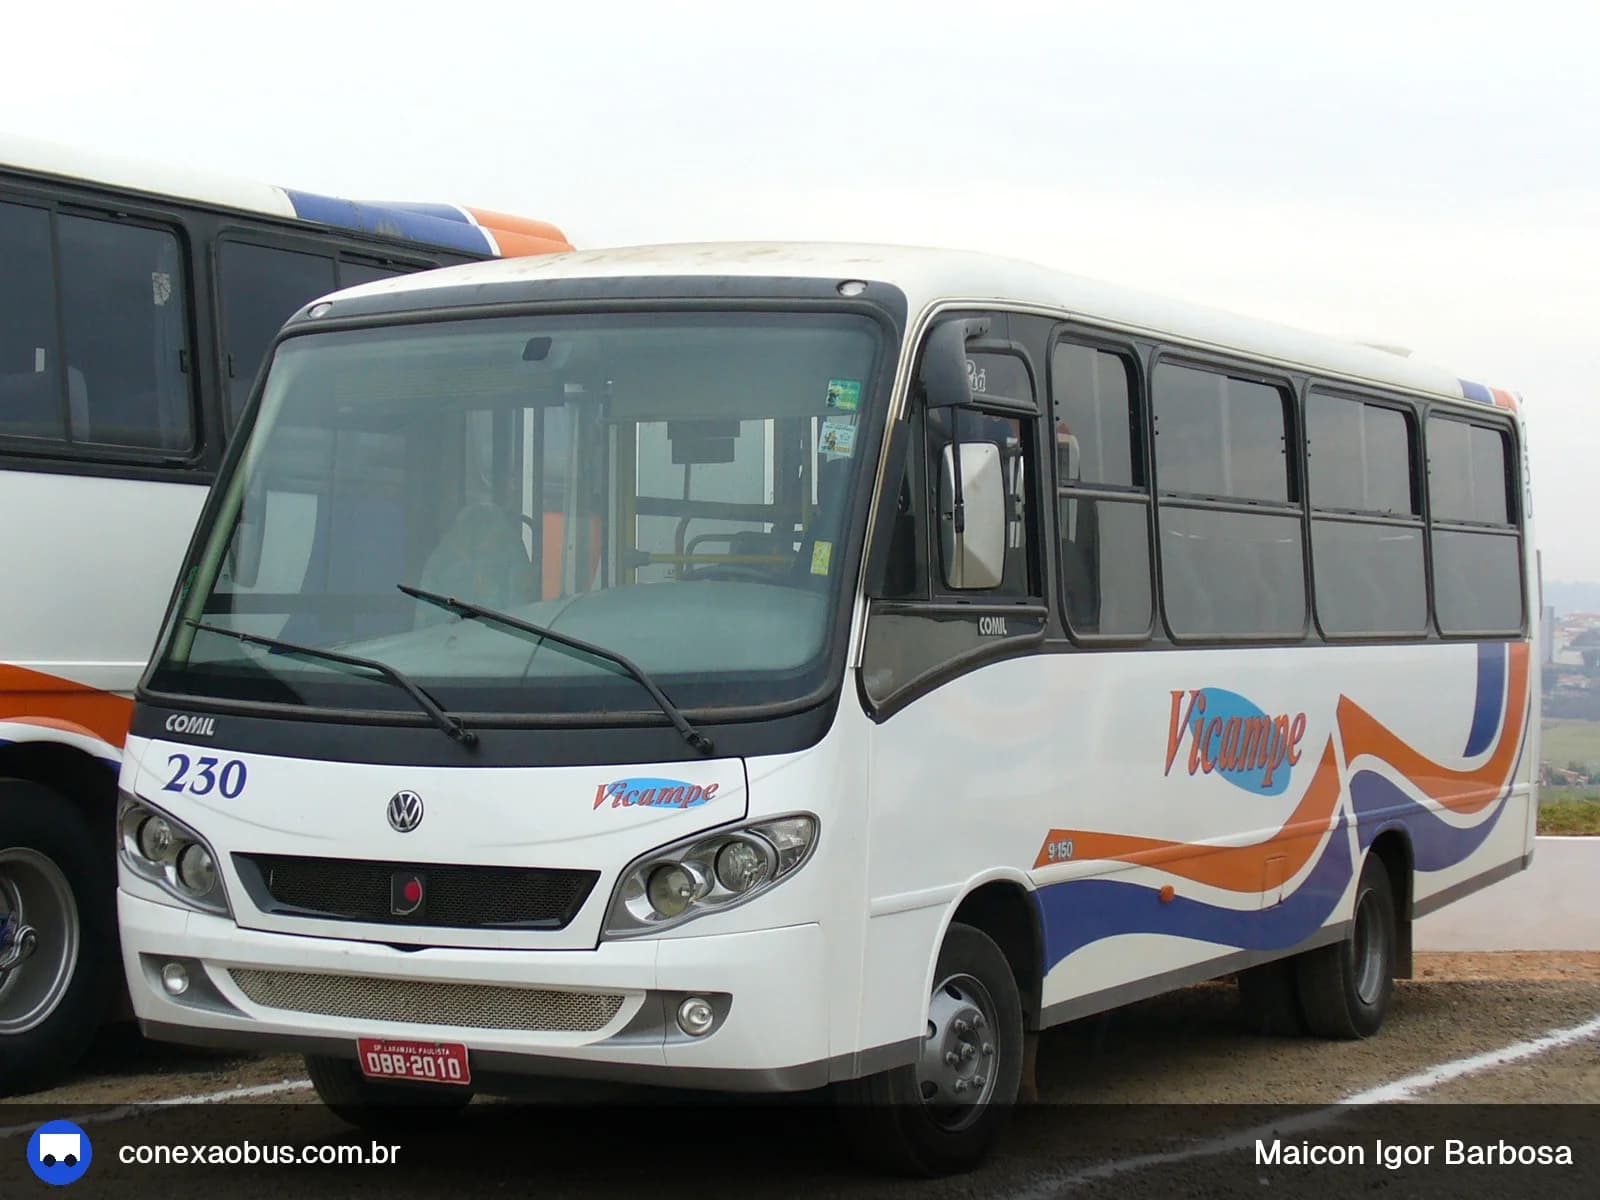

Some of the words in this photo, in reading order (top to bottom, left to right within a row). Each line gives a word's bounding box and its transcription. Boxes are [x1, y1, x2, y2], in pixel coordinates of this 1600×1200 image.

[979, 616, 1007, 635] COMIL
[165, 714, 216, 736] COMIL
[1164, 689, 1306, 788] Vicampe
[161, 753, 247, 799] 230
[593, 783, 719, 810] Vicampe
